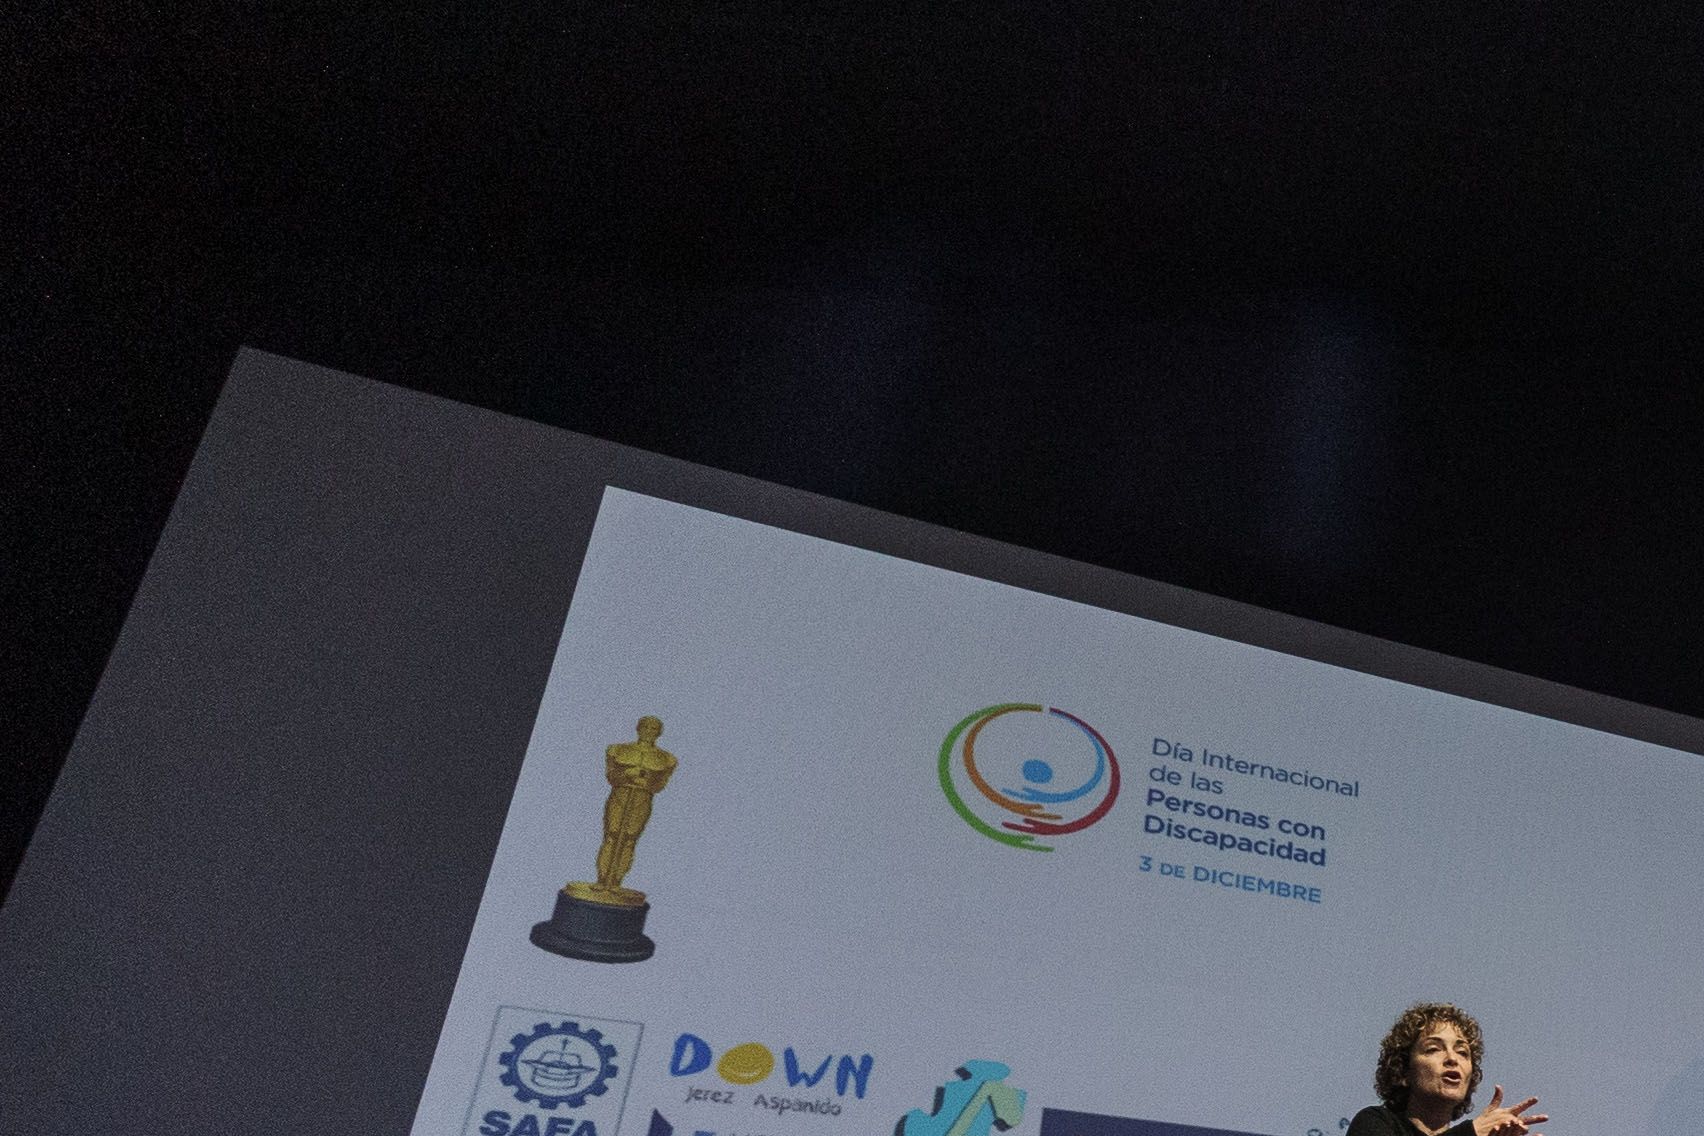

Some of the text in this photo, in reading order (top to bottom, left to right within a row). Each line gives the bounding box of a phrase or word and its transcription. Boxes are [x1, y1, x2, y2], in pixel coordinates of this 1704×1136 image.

[1149, 764, 1223, 795] de las
[1151, 738, 1360, 797] Día Internacional
[1143, 814, 1327, 867] Discapacidad
[1147, 788, 1326, 841] Personas con
[1139, 855, 1322, 903] 3 DE DICIEMBRE
[670, 1033, 875, 1100] DOWN
